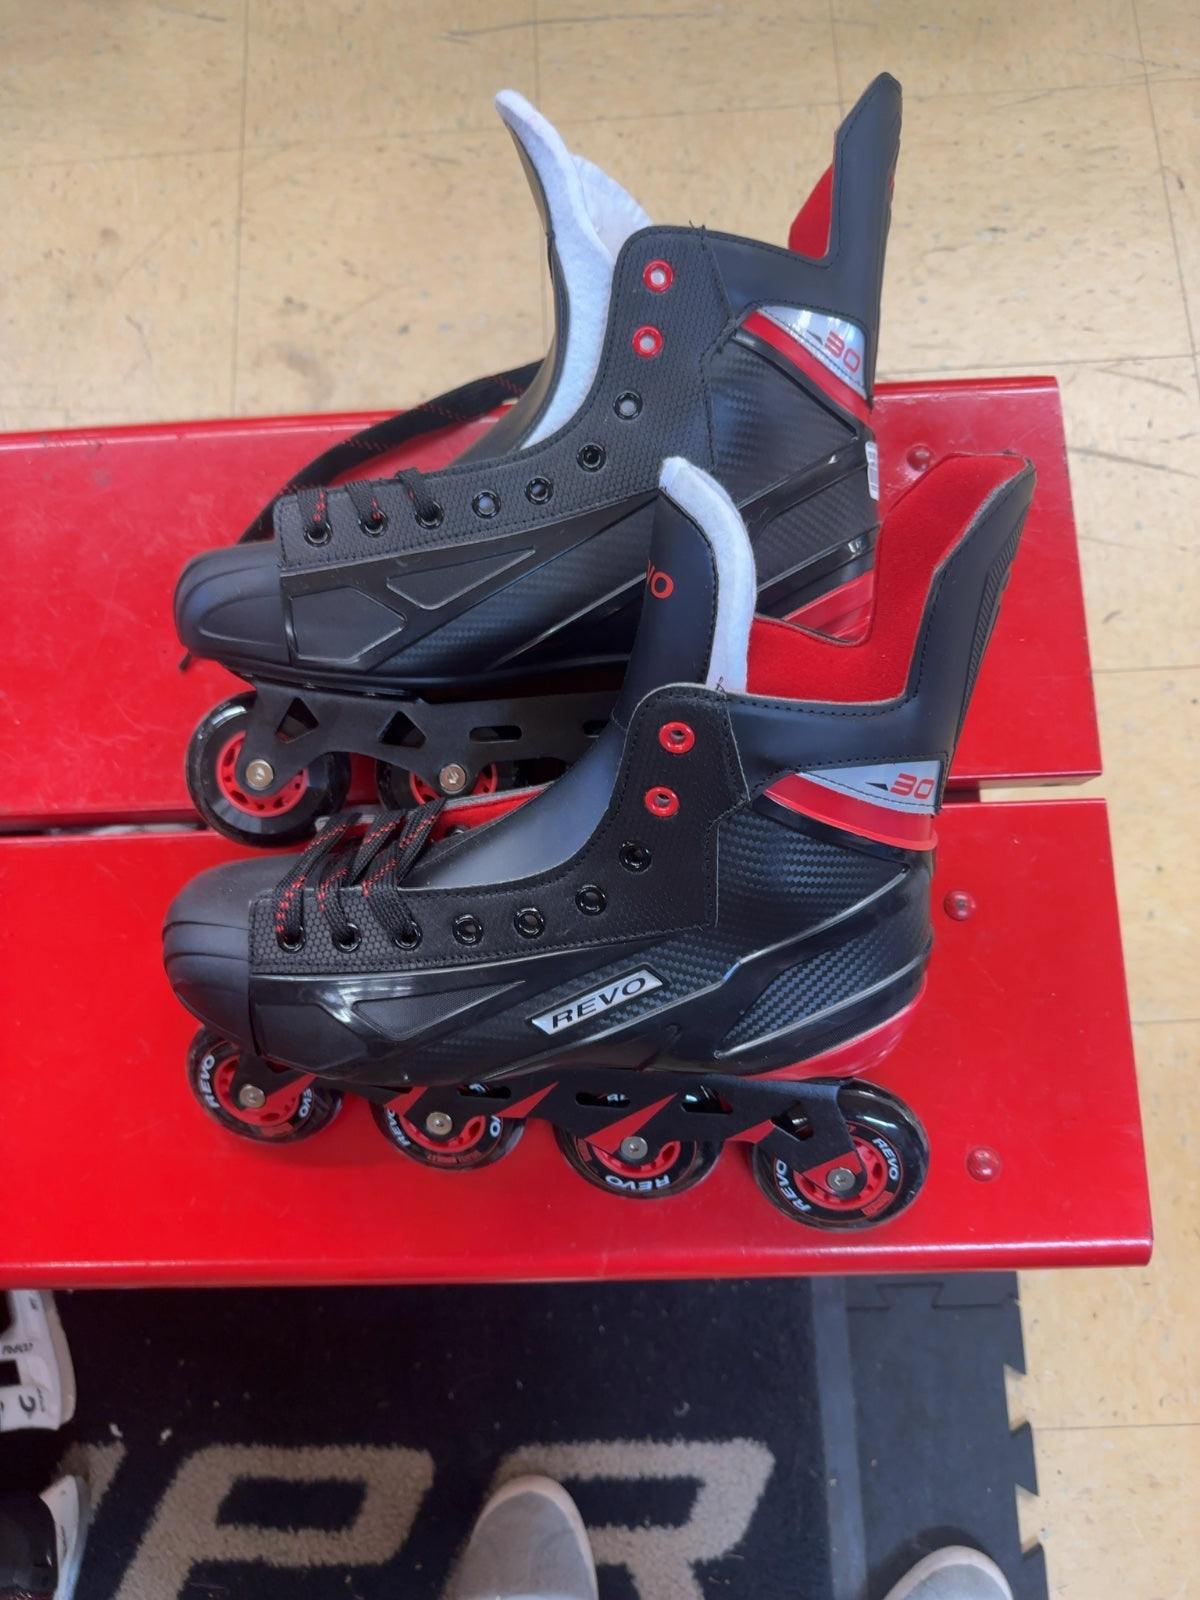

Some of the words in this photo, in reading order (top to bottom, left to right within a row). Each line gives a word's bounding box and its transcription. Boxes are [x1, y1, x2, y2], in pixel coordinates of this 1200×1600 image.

[824, 330, 861, 373] 30
[889, 772, 936, 800] 30
[552, 977, 646, 1029] REVO
[199, 1054, 220, 1109] REVO
[872, 1138, 900, 1182] REVO
[605, 1174, 670, 1192] REVO
[775, 1159, 812, 1212] REVO
